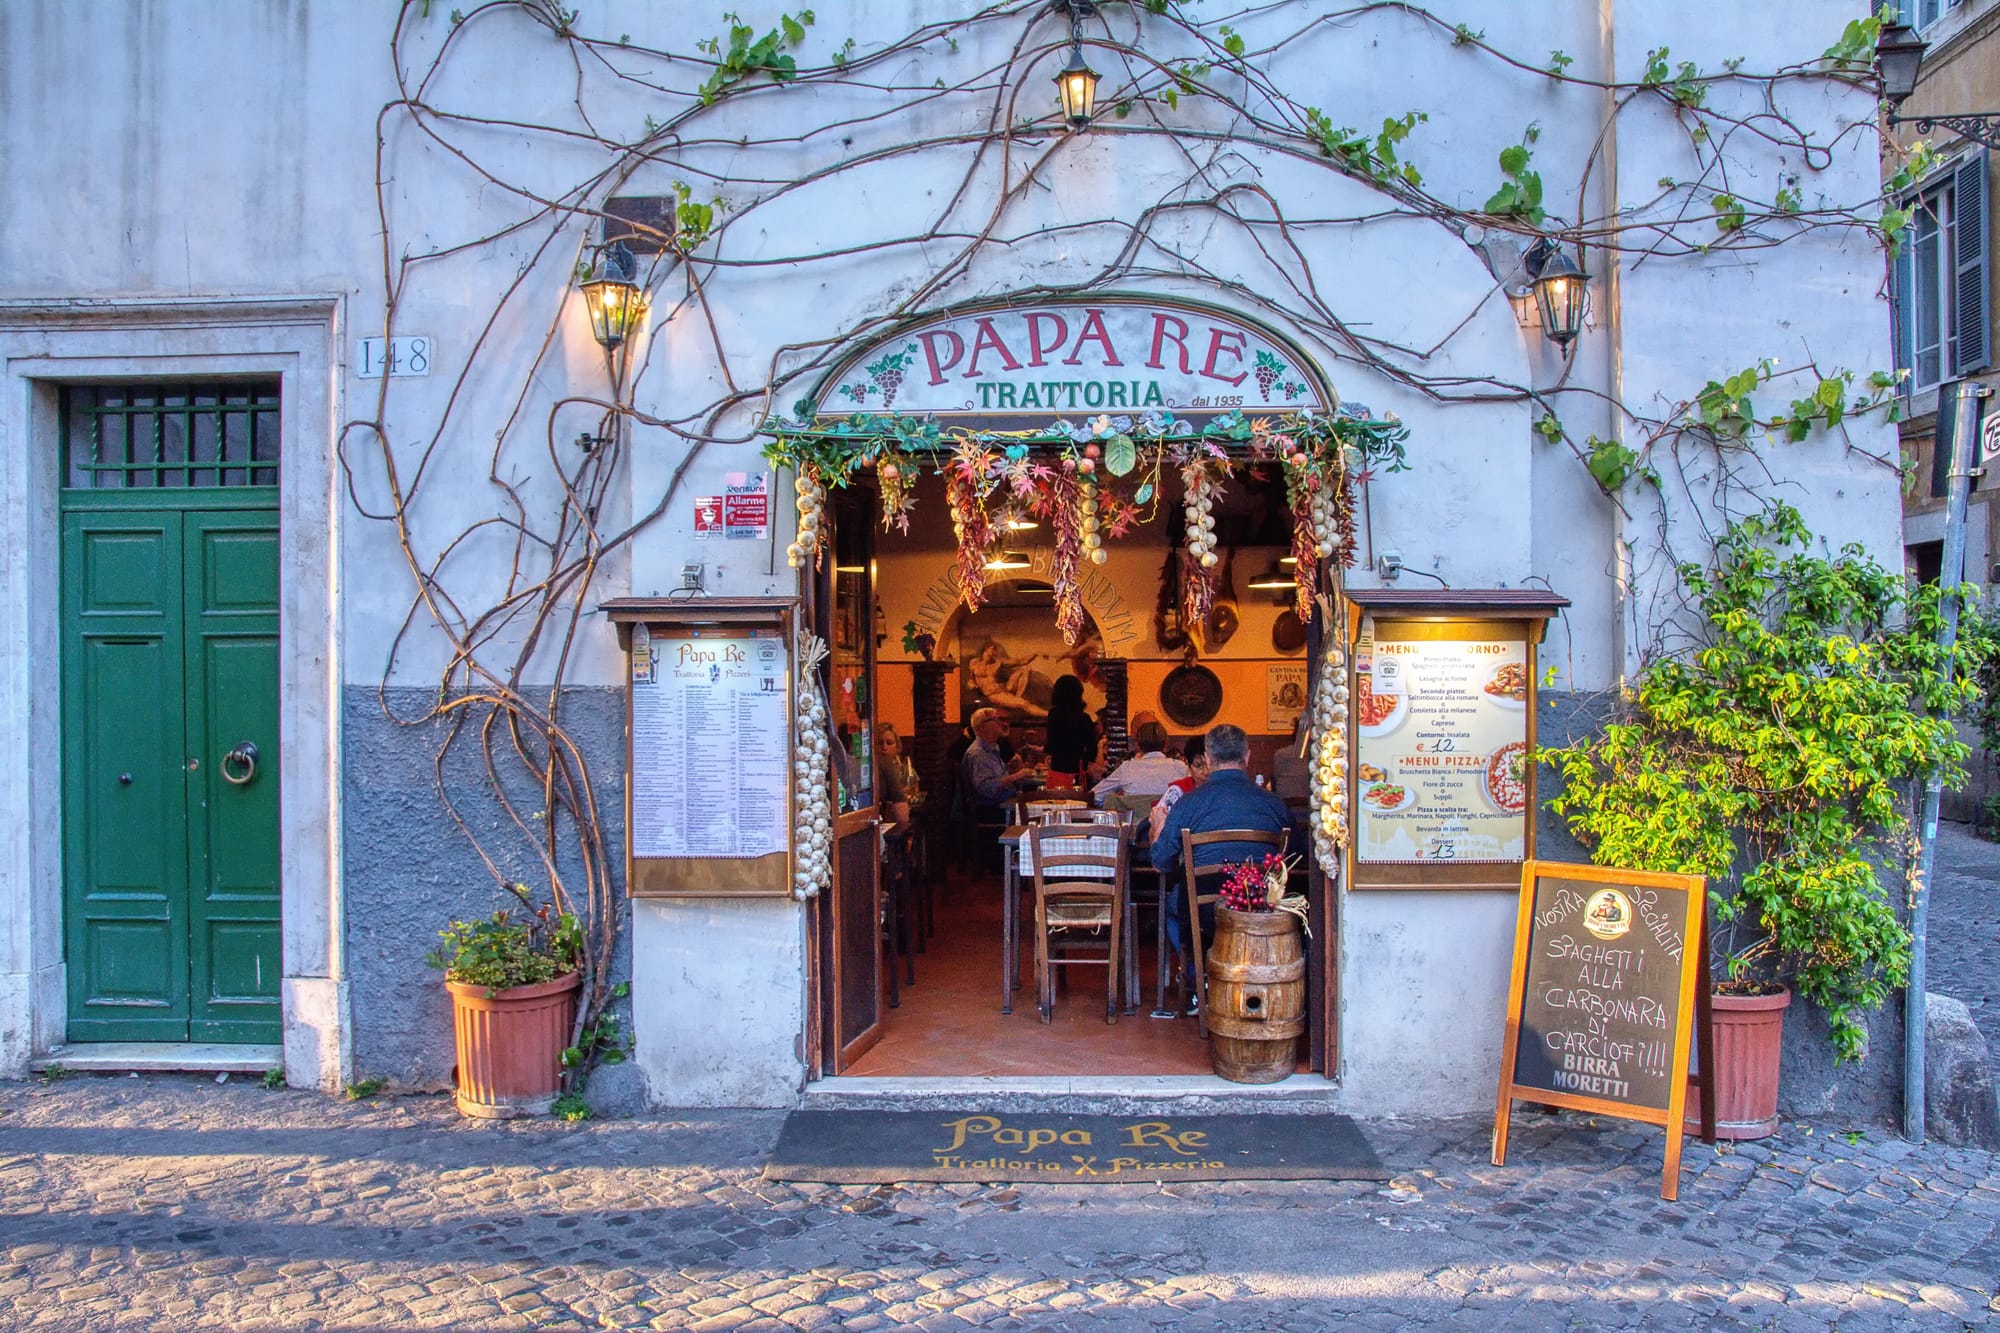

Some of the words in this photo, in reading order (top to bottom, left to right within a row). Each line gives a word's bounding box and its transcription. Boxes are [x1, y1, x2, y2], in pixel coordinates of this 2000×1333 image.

[363, 338, 427, 374] 148
[916, 308, 1124, 386] PAPA
[1145, 312, 1249, 388] RE
[976, 380, 1165, 408] TRATTORIA
[1192, 396, 1210, 407] dal
[1214, 396, 1244, 407] 1935
[728, 496, 766, 505] Allarme
[674, 643, 716, 668] Papa
[722, 644, 746, 668] Re
[1386, 645, 1419, 654] MENU
[1416, 743, 1424, 752] €
[1432, 739, 1454, 753] 12
[1406, 757, 1439, 766] MENU
[1446, 757, 1480, 766] PIZZA
[1430, 845, 1455, 859] 13
[1535, 888, 1587, 931] NOSTRA
[1578, 966, 1624, 991] ALLA
[1545, 988, 1666, 1030] CARBONARA
[1564, 1054, 1620, 1077] BIRRA
[1553, 1070, 1629, 1098] MORETTI
[933, 1116, 1092, 1154] Papa
[1120, 1122, 1209, 1155] Re
[934, 1156, 1061, 1171] Trattoria
[1106, 1157, 1225, 1175] Pizzeria
